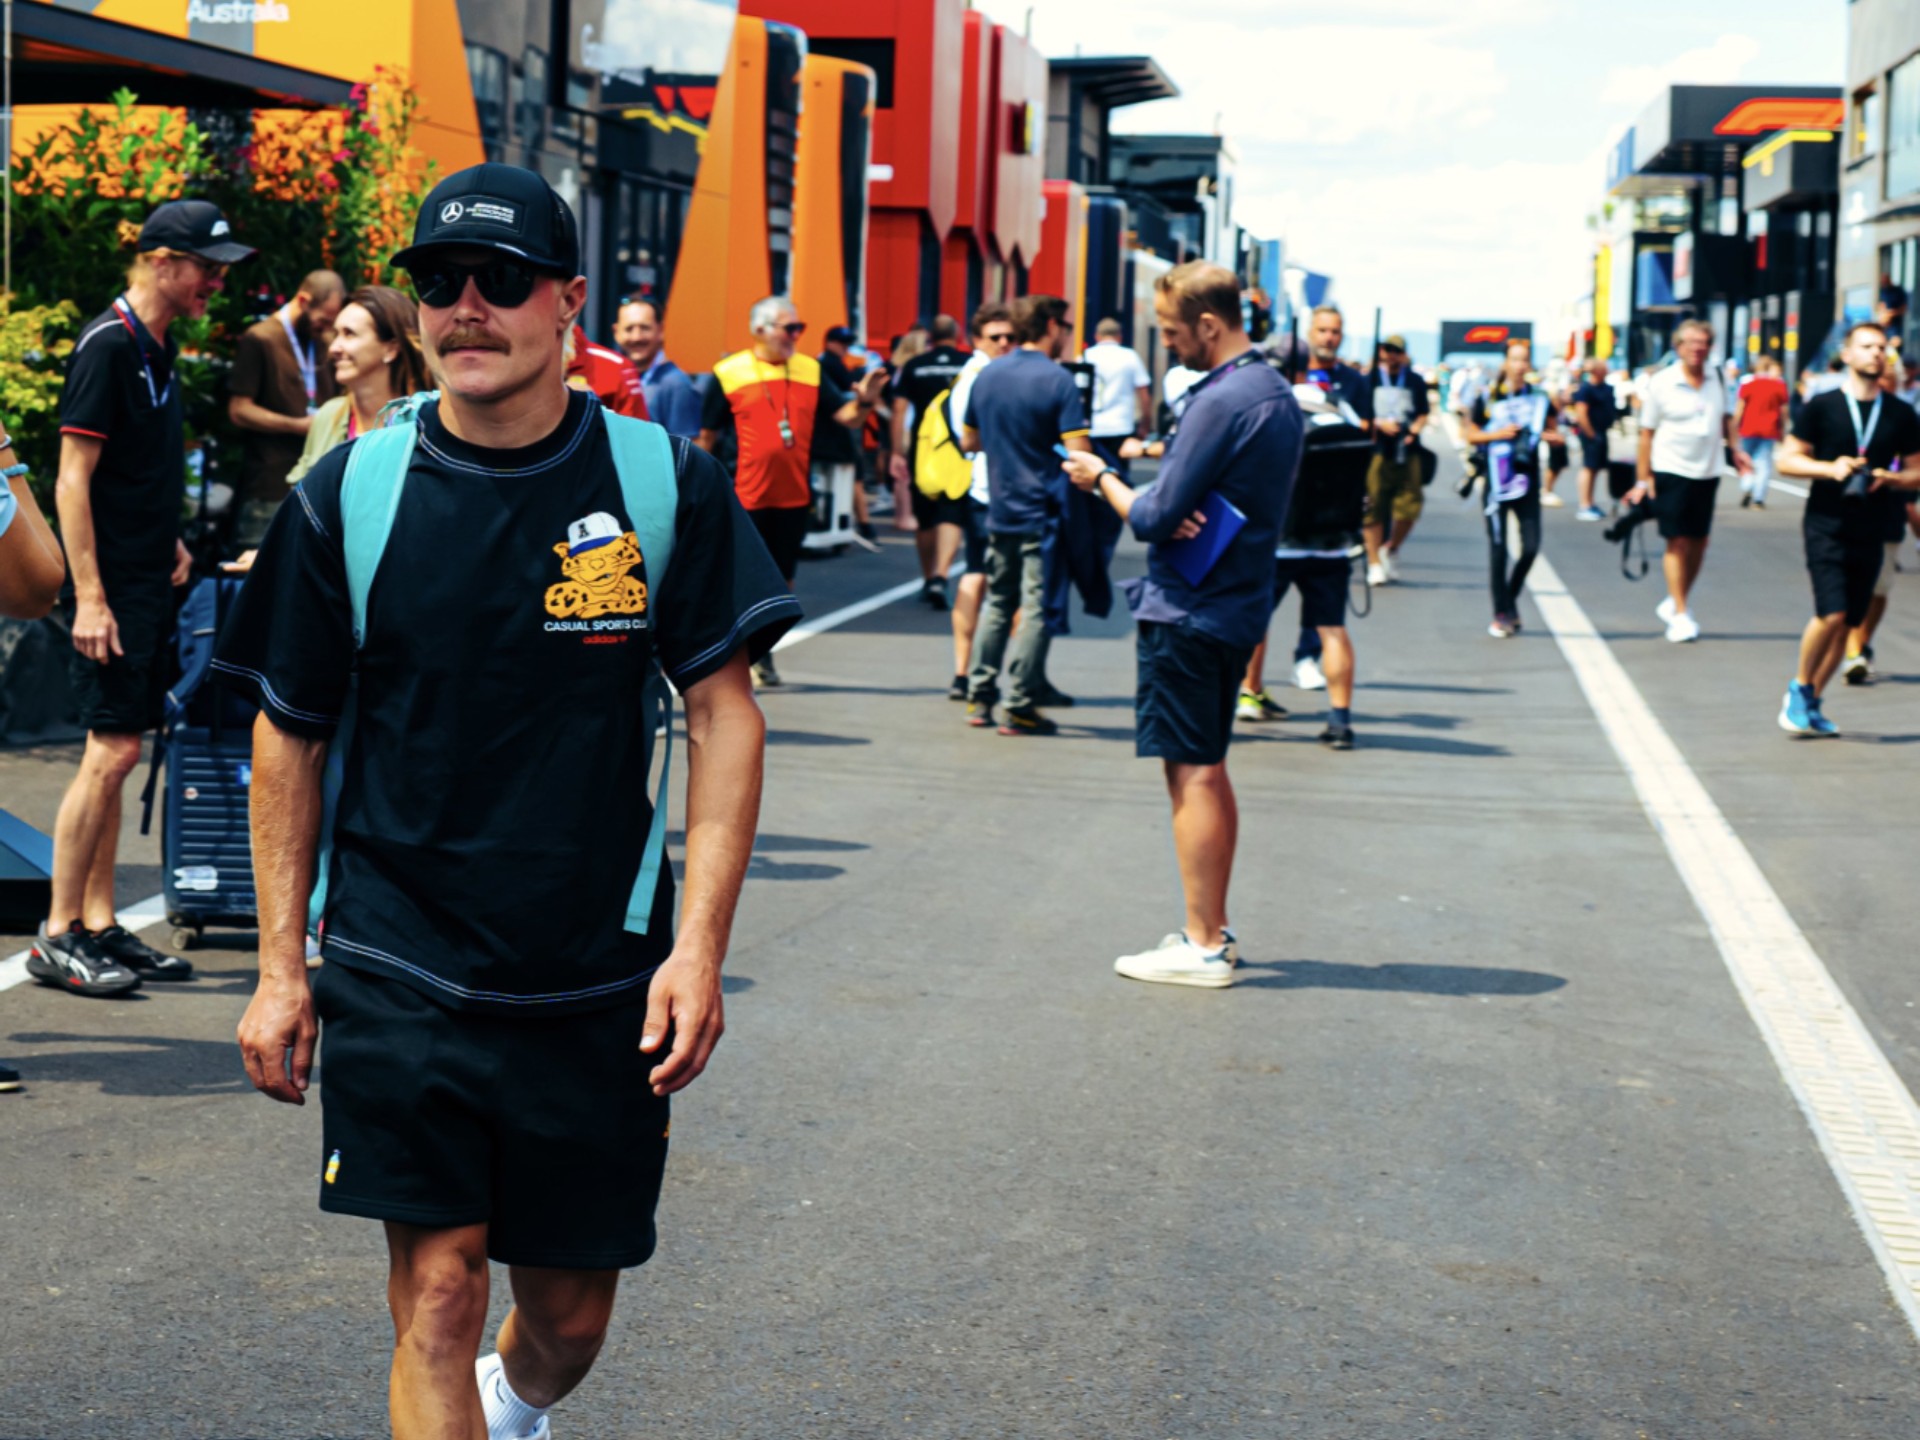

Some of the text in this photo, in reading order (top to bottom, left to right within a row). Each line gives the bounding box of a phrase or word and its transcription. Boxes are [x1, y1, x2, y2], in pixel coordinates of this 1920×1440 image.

[186, 0, 289, 23] Australia
[544, 621, 590, 632] CASUAL
[592, 619, 631, 631] SPORTS
[583, 634, 618, 644] adidas
